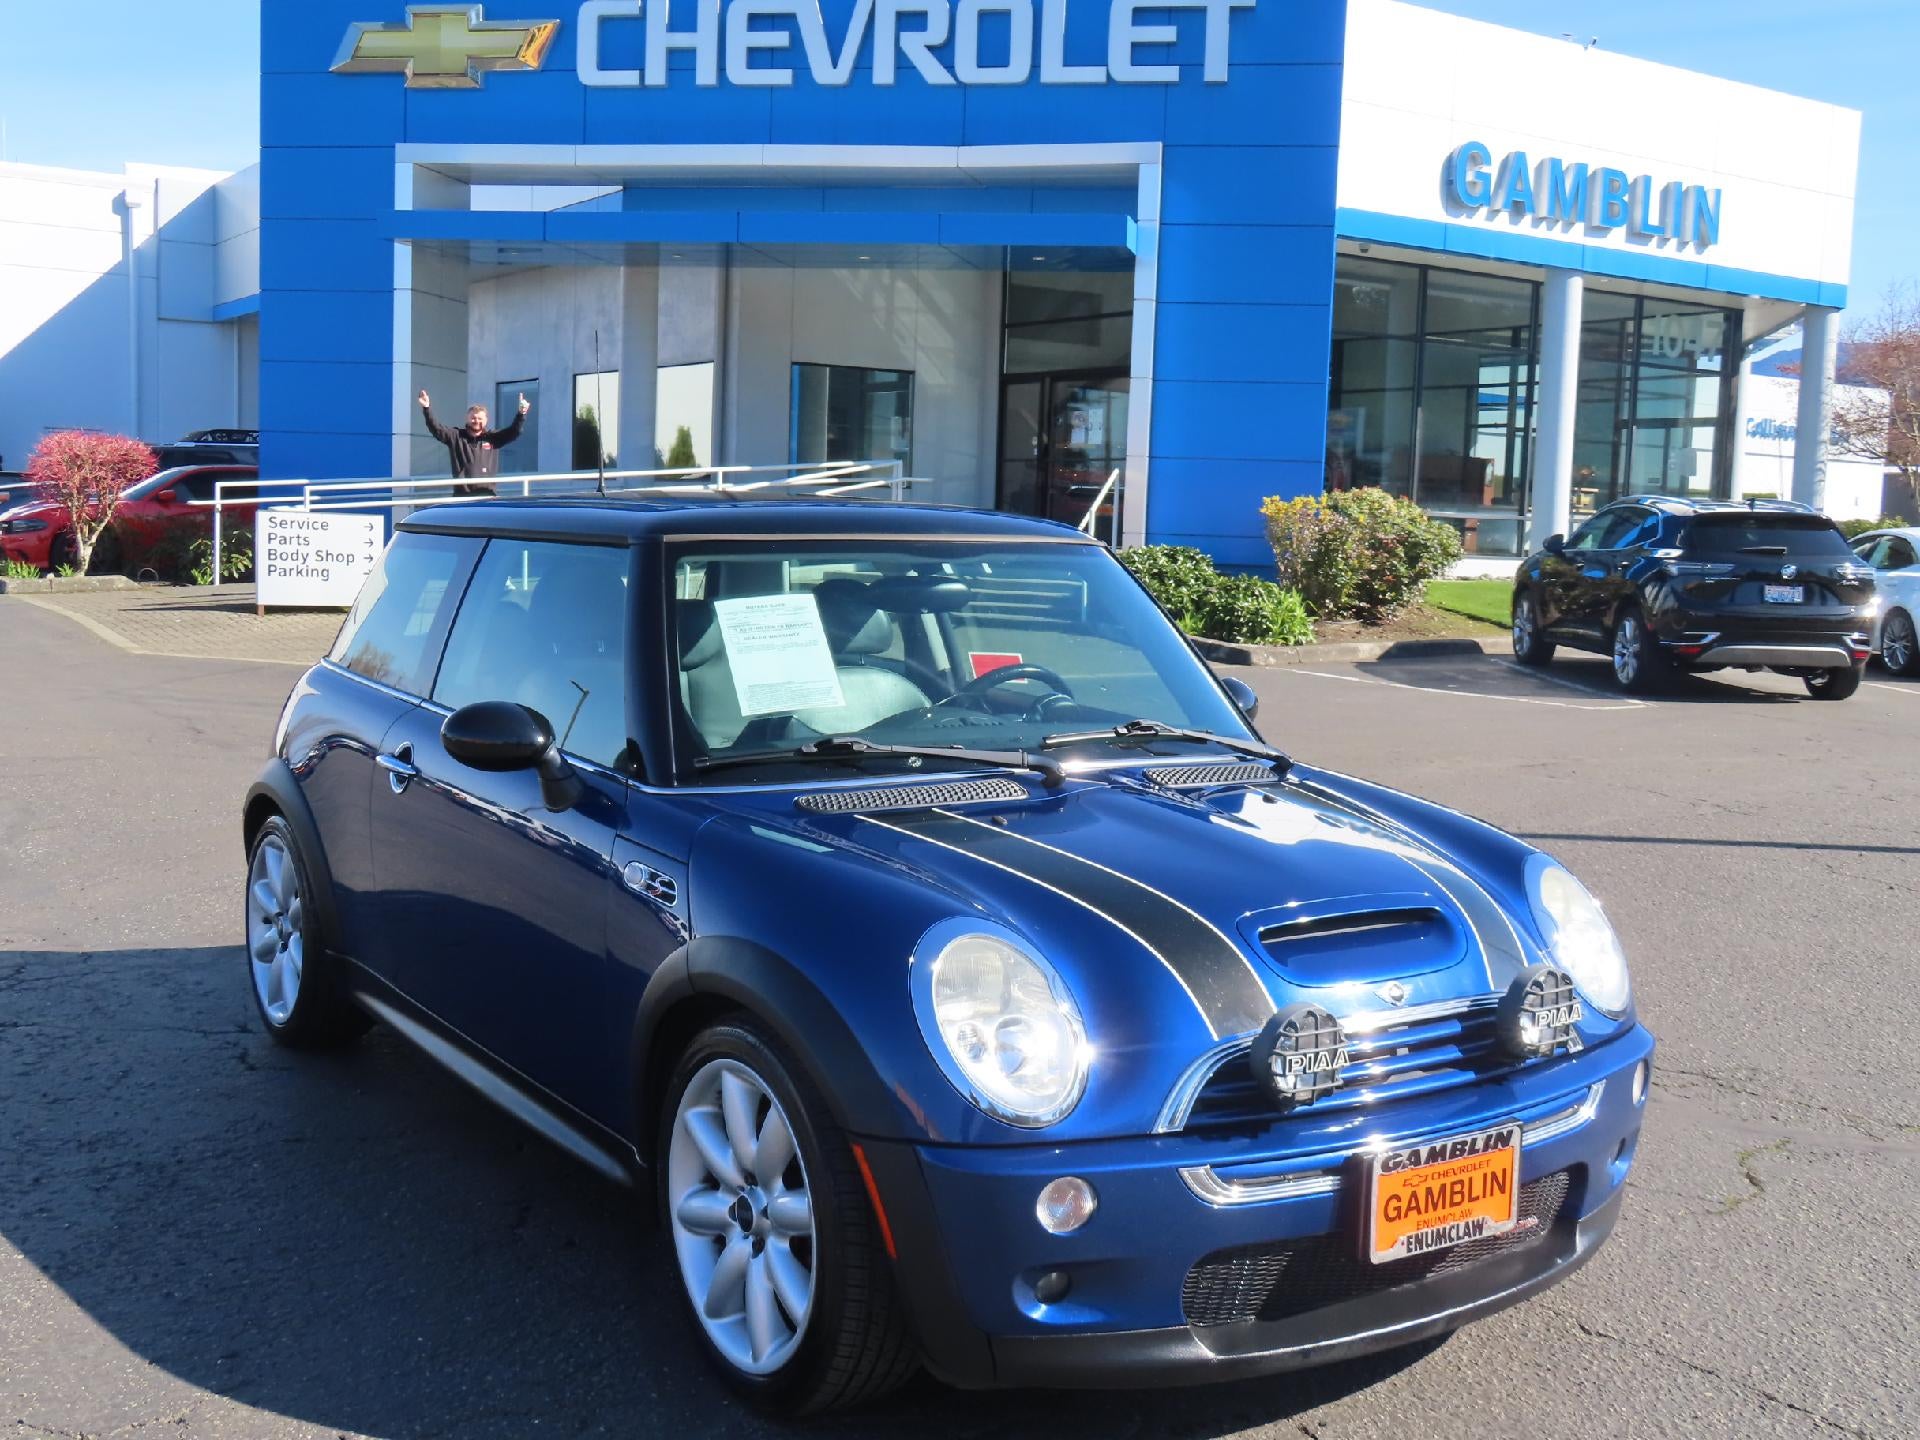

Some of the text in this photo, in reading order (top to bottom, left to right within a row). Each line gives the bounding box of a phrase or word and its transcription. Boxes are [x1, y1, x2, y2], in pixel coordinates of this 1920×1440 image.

[576, 0, 1256, 87] CHEVROLET
[1445, 141, 1722, 248] GAMBLIN
[268, 516, 329, 531] Service
[267, 532, 310, 546] Parts
[267, 548, 355, 566] Body Shop
[267, 564, 330, 581] Parking
[1535, 1003, 1582, 1029] PIAA
[1286, 1048, 1350, 1075] PIAA
[1380, 1129, 1514, 1174] GAMBLIN
[1430, 1158, 1492, 1181] CHEVROLET
[1383, 1167, 1507, 1224] GAMBLIN
[1416, 1208, 1473, 1230] ENUMCLAW
[1406, 1217, 1486, 1253] ENUMCLAW
